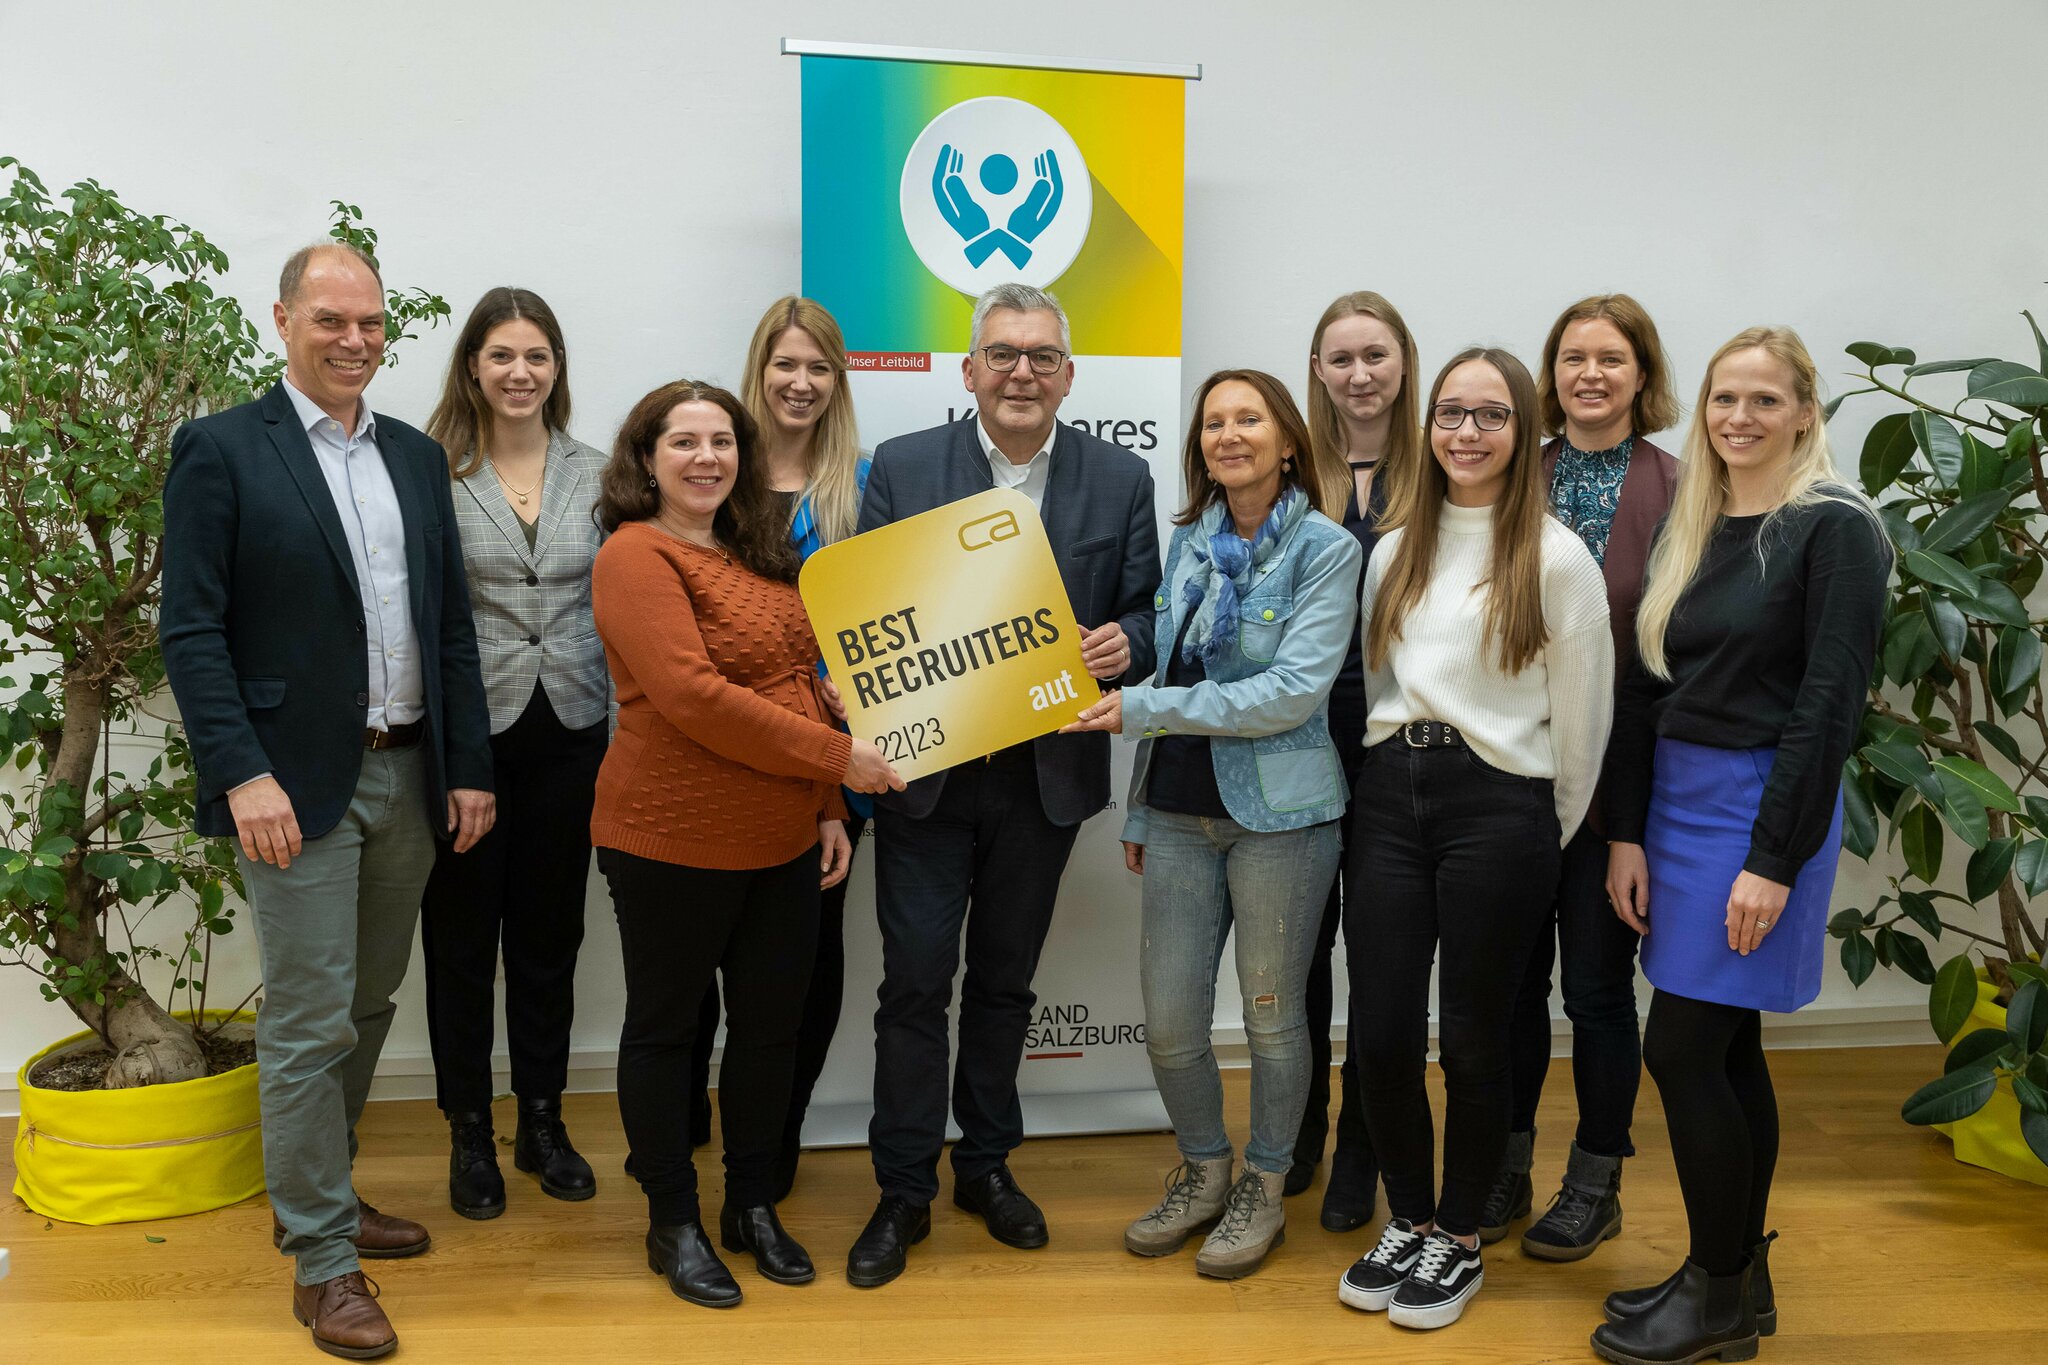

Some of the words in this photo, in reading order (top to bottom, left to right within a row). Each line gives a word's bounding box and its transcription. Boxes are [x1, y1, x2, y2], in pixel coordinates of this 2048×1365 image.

[880, 356, 925, 368] Leitbild
[837, 606, 921, 667] BEST
[851, 607, 1060, 709] RECRUITERS
[1028, 670, 1079, 712] aut
[1025, 1023, 1146, 1049] SALZBURG
